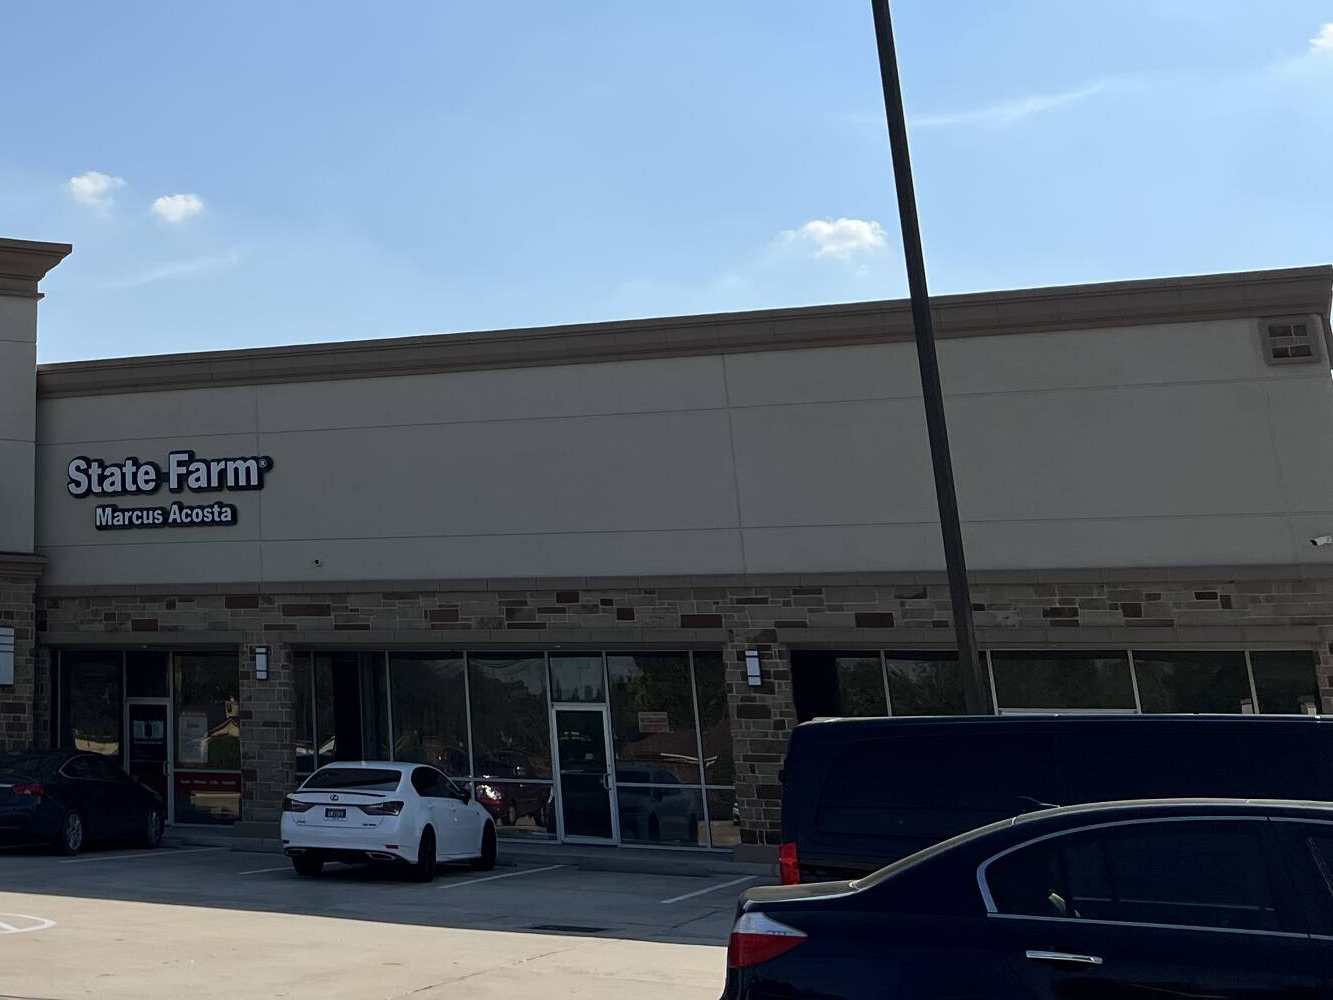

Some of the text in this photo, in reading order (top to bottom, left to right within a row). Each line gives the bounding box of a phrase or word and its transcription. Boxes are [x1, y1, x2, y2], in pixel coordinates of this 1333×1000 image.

[66, 457, 157, 496] State
[95, 503, 233, 527] Marcus Acosta
